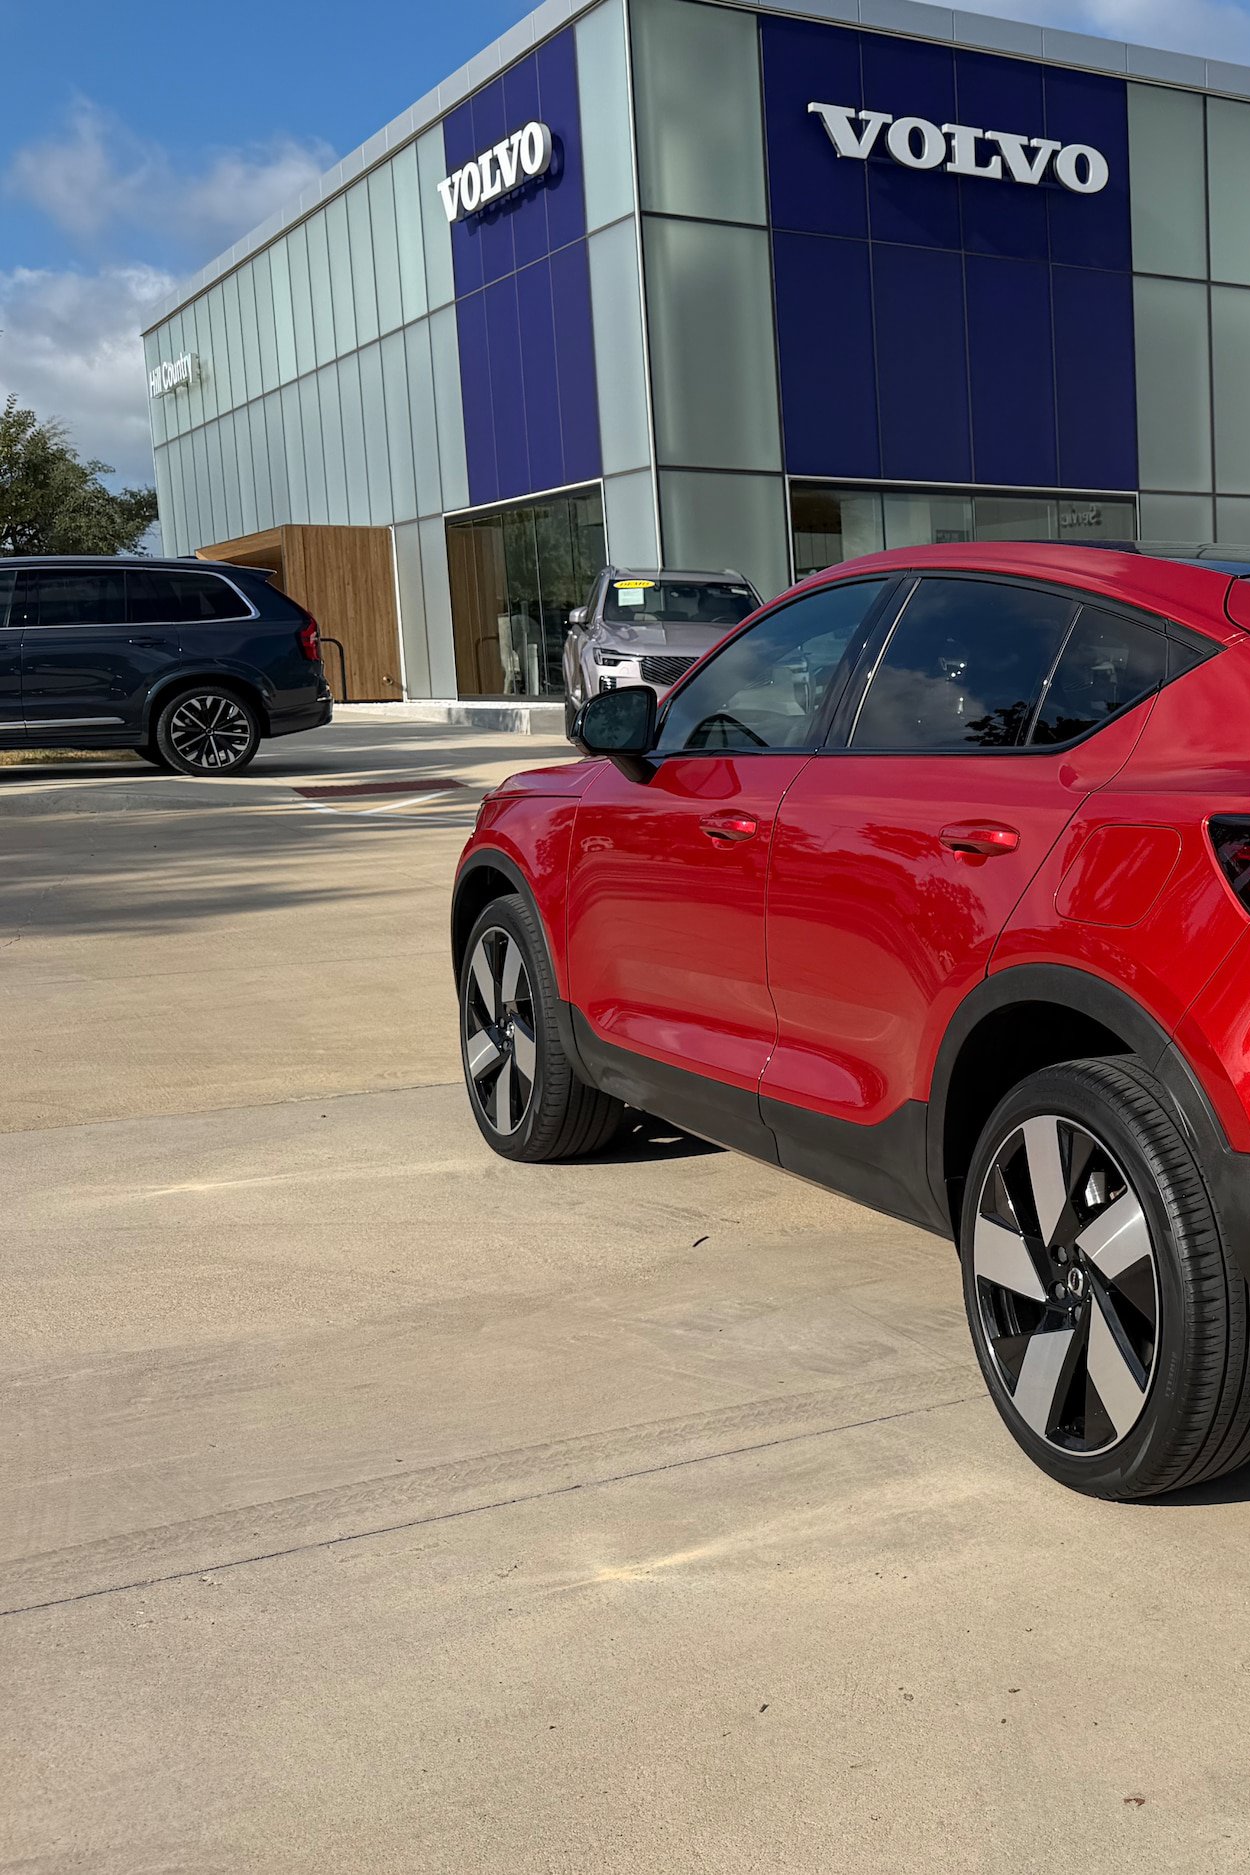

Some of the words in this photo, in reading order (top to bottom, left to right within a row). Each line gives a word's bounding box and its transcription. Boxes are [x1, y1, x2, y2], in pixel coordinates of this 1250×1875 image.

[437, 121, 550, 222] VOLVO
[808, 102, 1109, 194] VOLVO
[150, 366, 162, 398] Hill
[162, 352, 192, 389] Country
